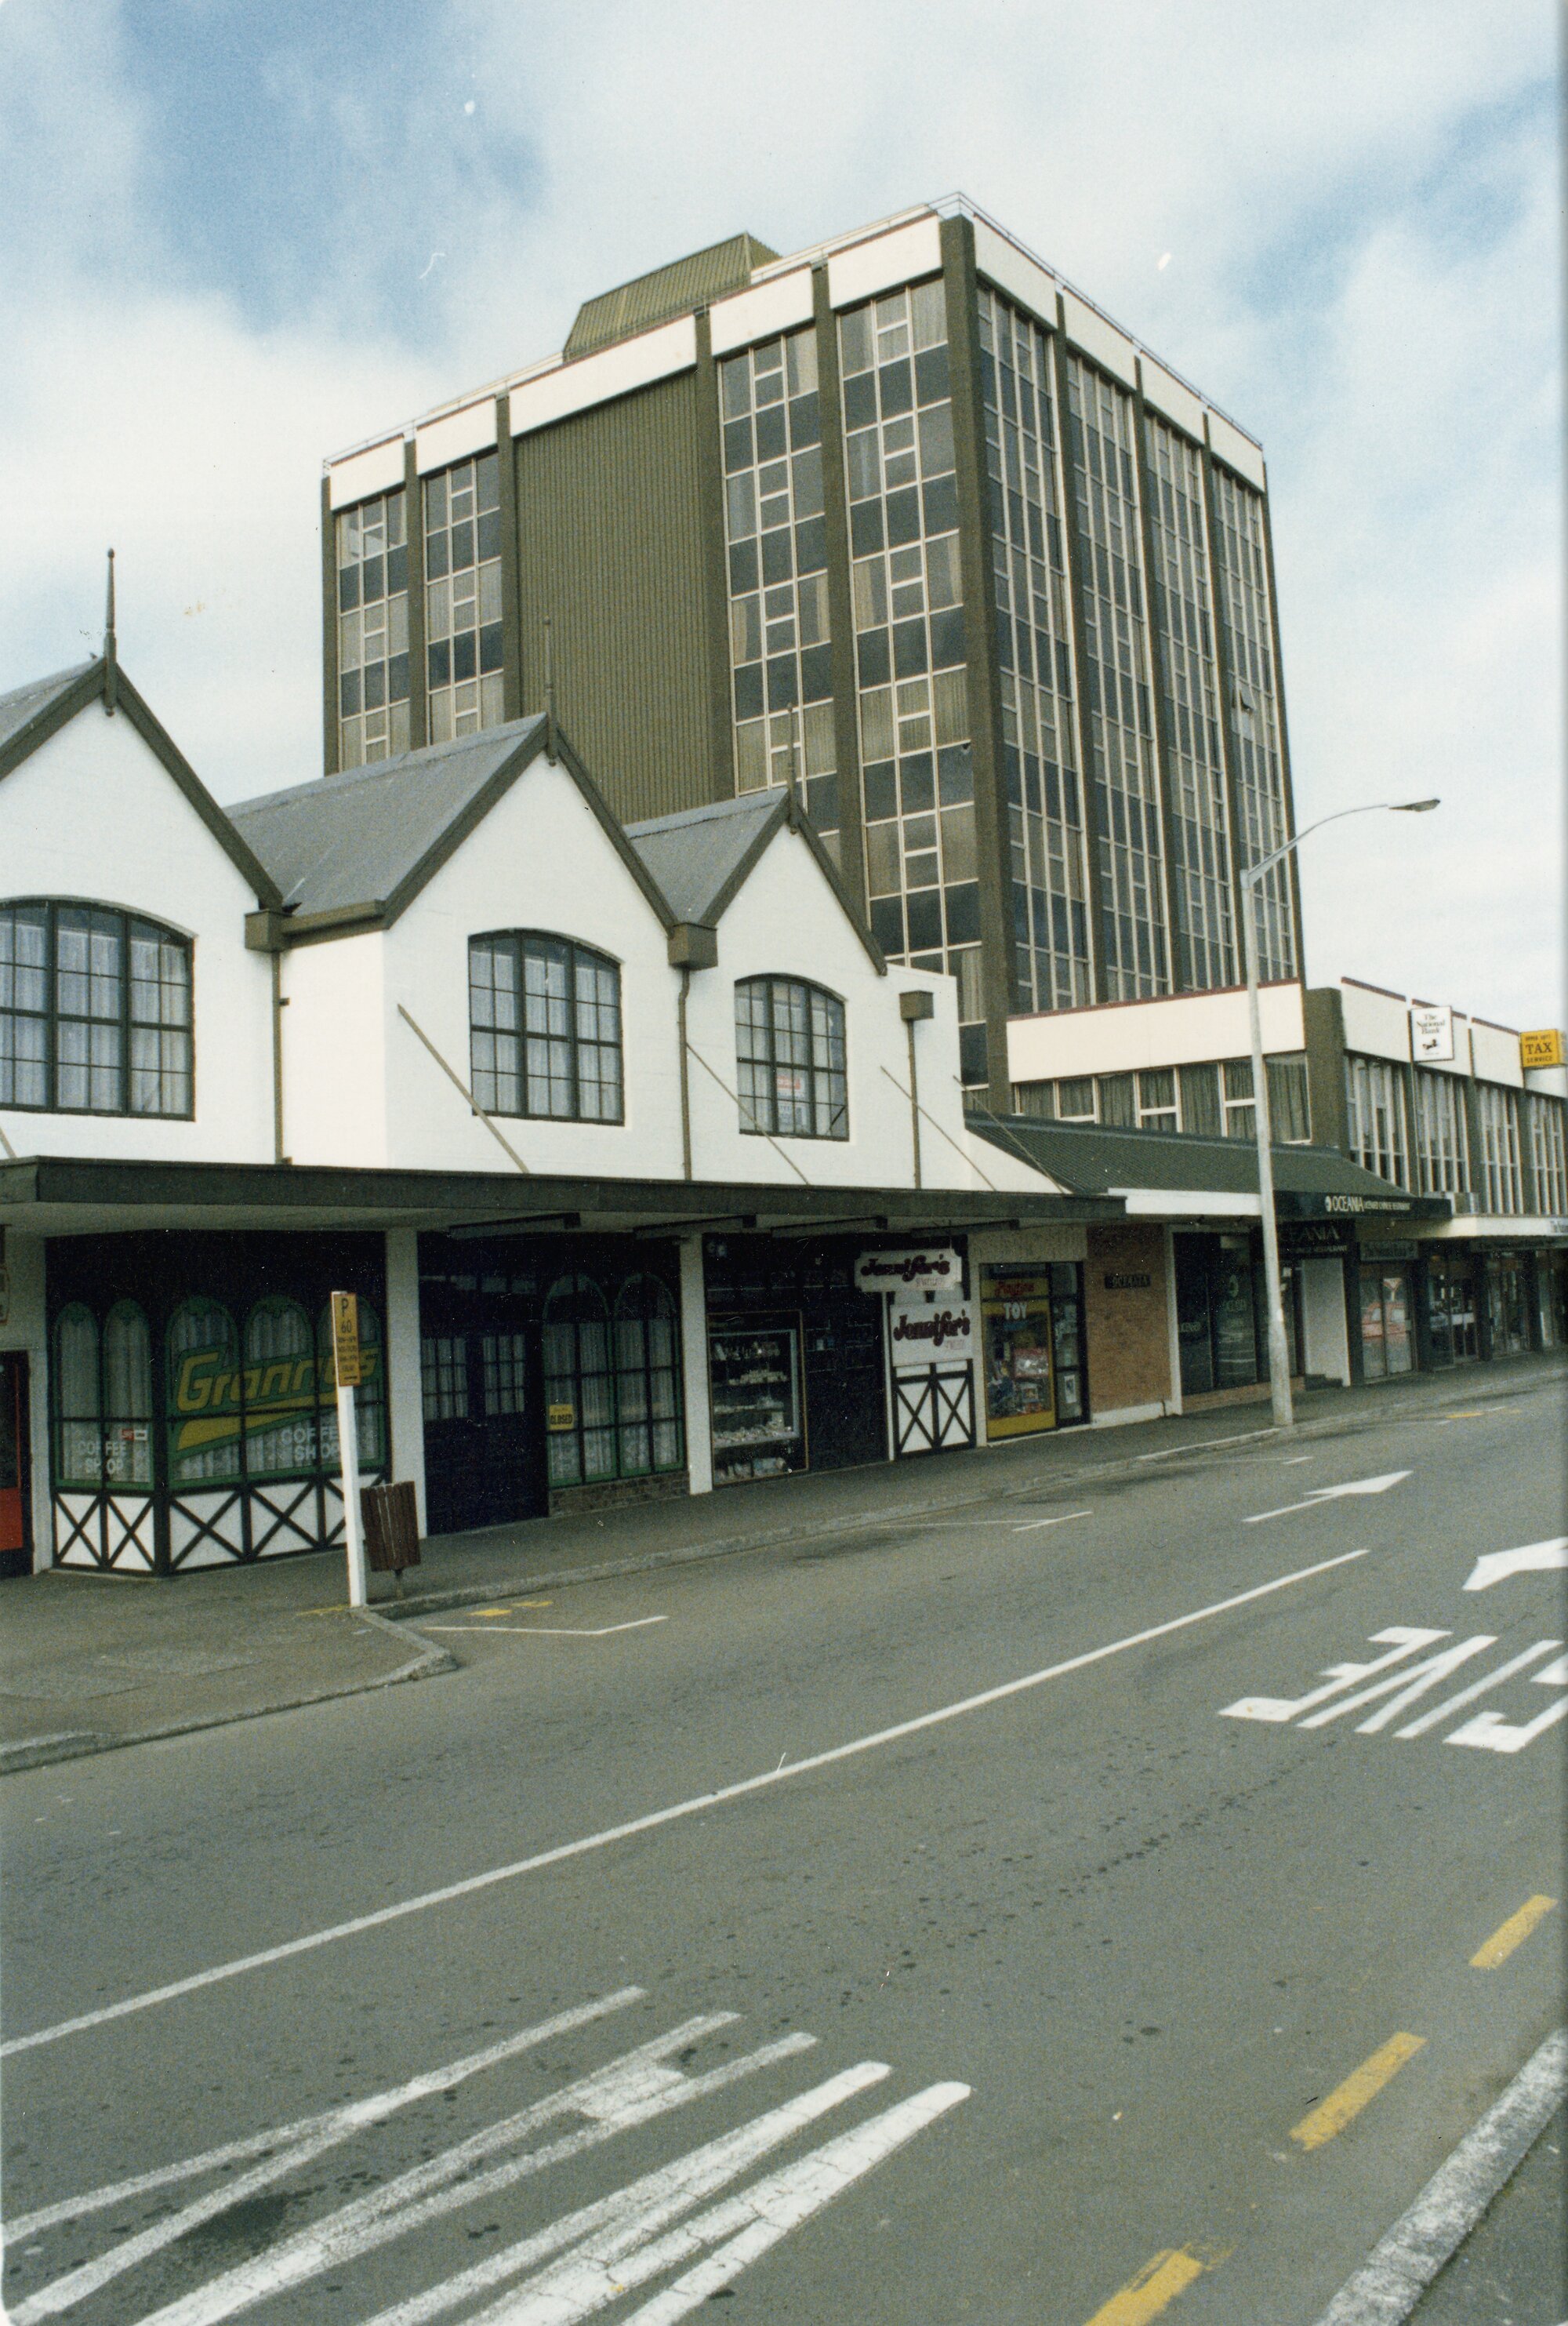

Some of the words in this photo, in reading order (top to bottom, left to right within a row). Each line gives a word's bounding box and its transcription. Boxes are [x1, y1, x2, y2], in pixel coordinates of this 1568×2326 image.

[1525, 1041, 1552, 1054] TAX
[1332, 1195, 1364, 1212] OCEANIA
[860, 1254, 950, 1282] Jennifer's
[340, 1298, 349, 1317] P
[1004, 1302, 1028, 1321] TOY
[341, 1320, 352, 1333] 60
[893, 1308, 971, 1347] Jennifer's
[550, 1413, 573, 1425] CLOSED
[281, 1426, 339, 1445] COFFE
